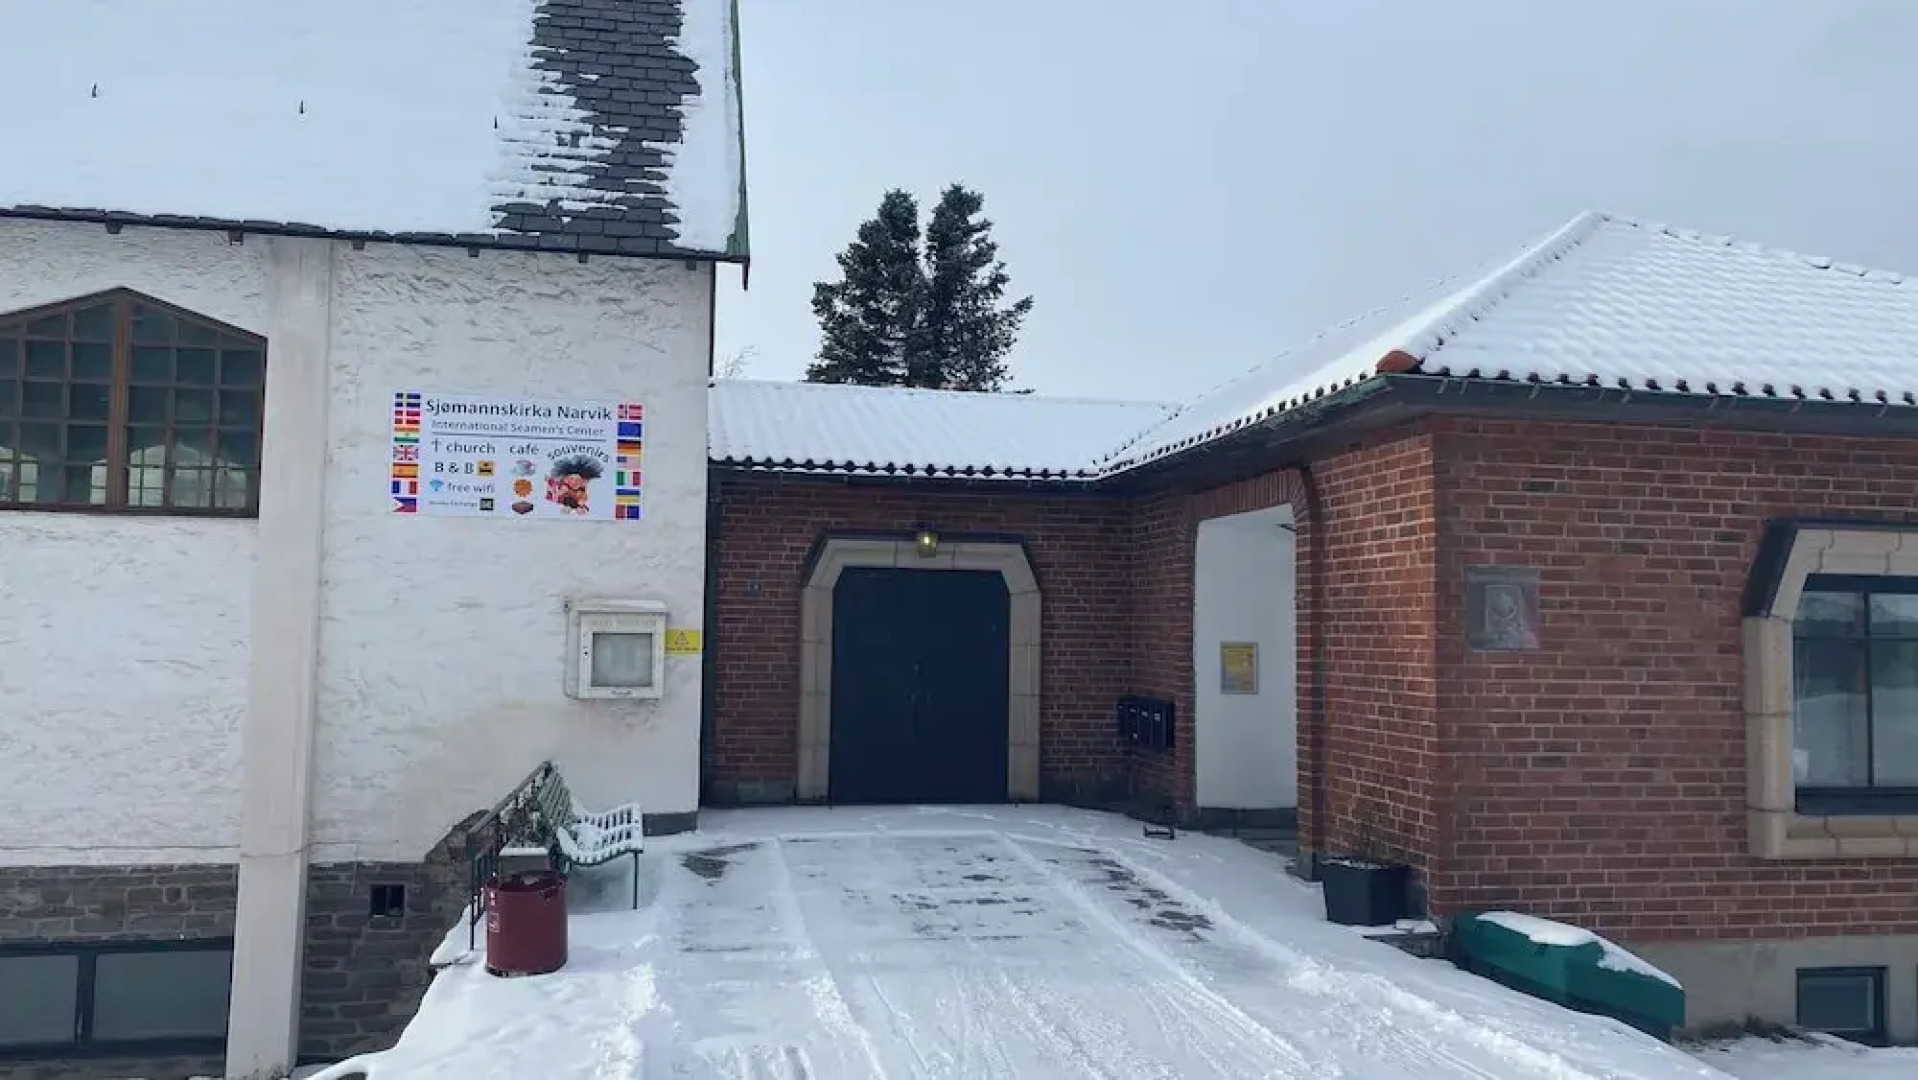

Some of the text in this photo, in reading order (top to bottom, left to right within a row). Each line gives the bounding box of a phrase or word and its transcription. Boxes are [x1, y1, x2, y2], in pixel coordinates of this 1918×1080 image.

[426, 399, 612, 420] Sjømannskirka Narvik
[431, 420, 605, 435] International Seamen's Center
[446, 442, 495, 454] church
[510, 443, 539, 455] café
[547, 445, 610, 463] souvenirs
[434, 462, 444, 472] B
[447, 482, 495, 494] free wifi
